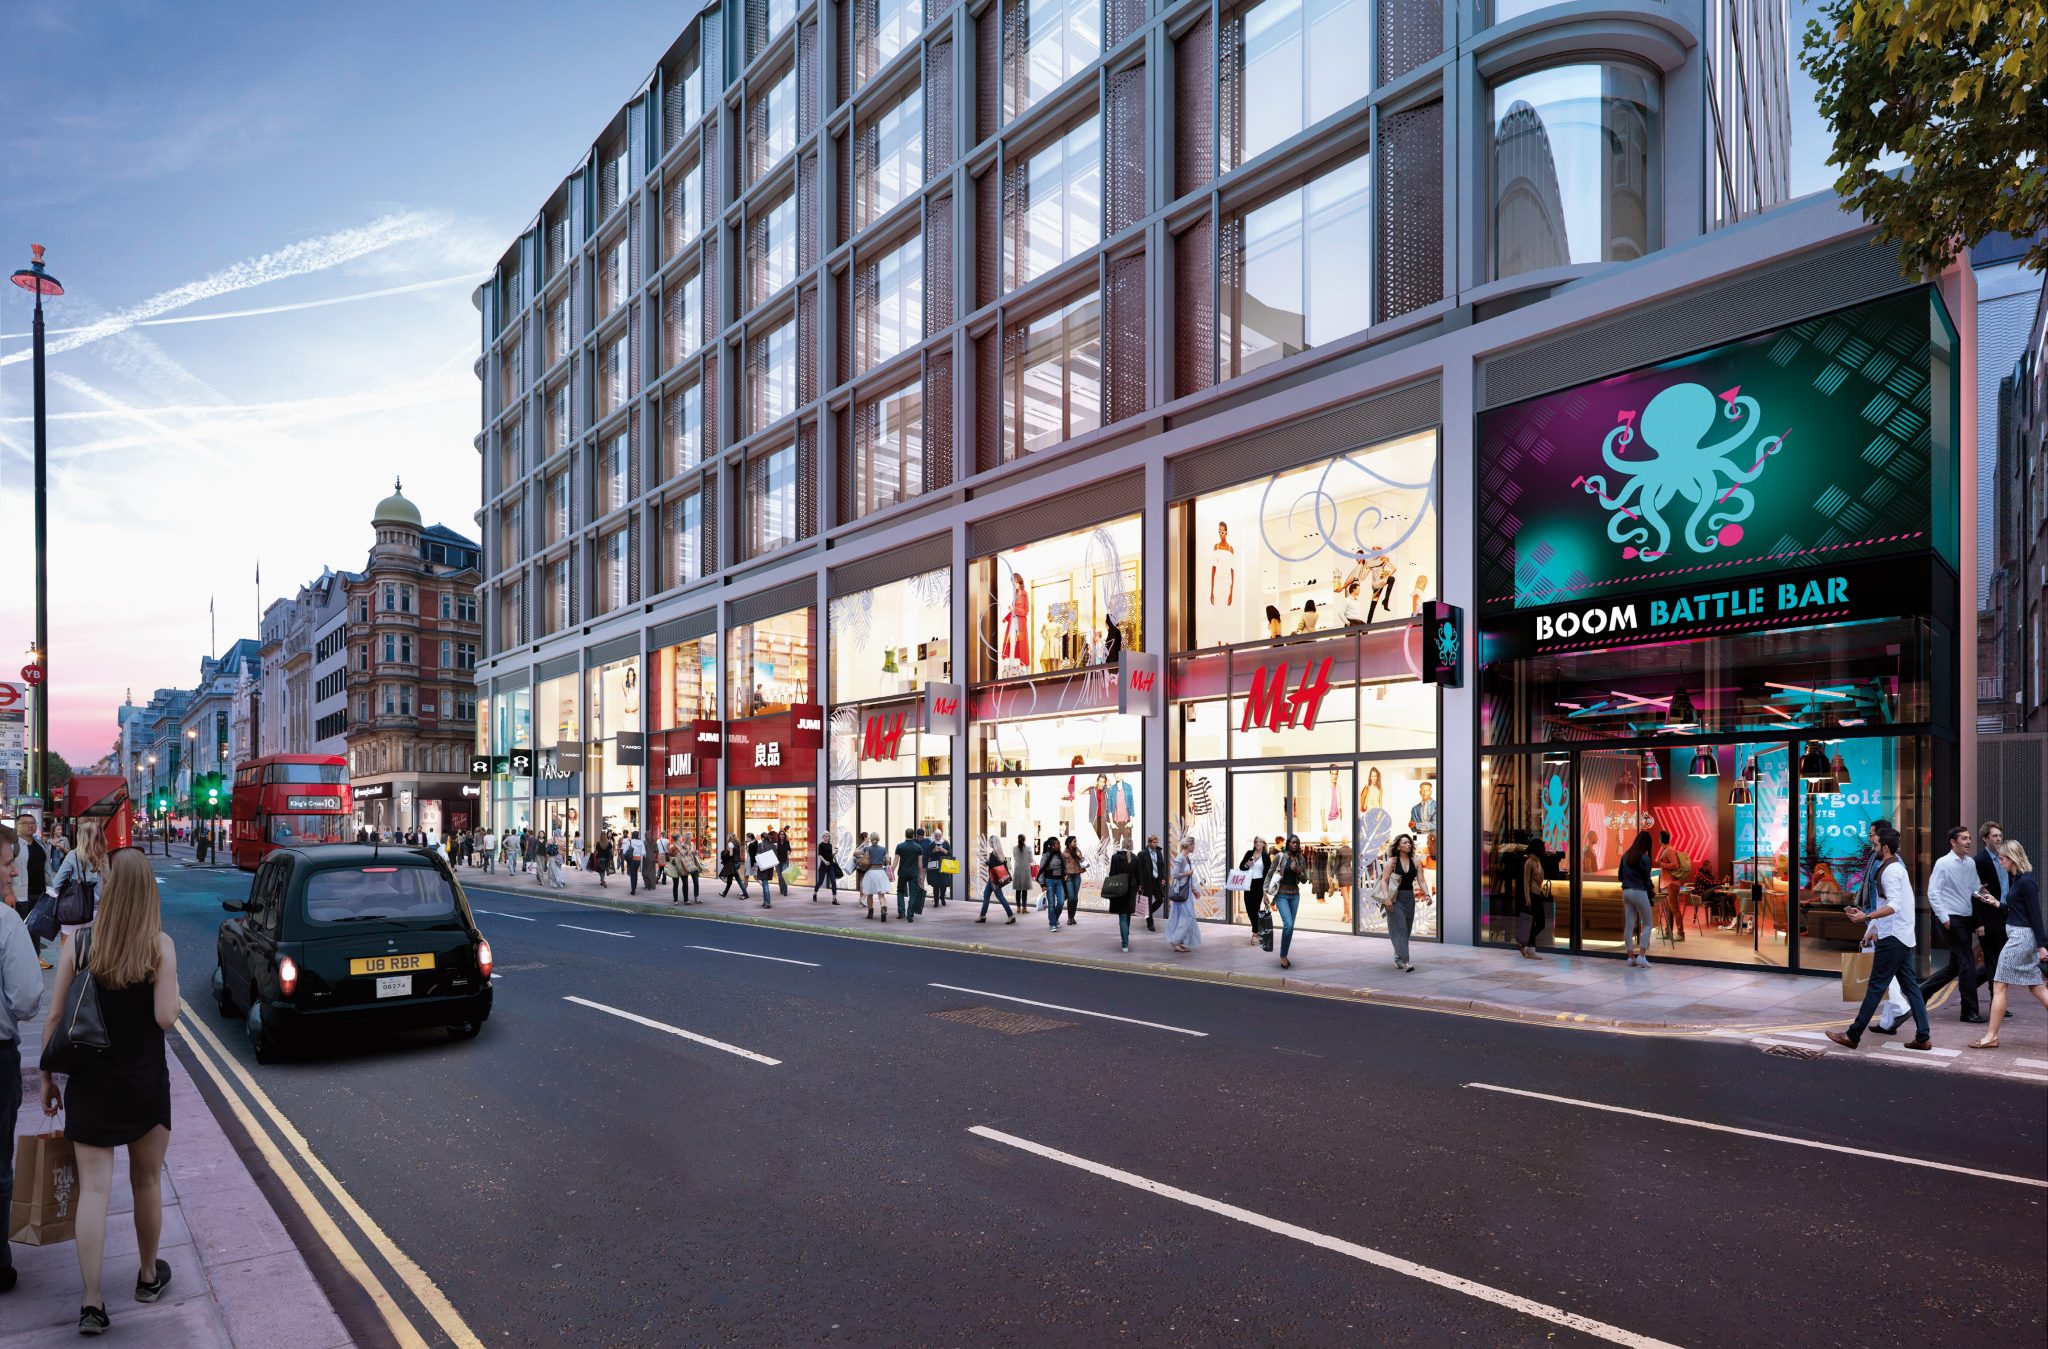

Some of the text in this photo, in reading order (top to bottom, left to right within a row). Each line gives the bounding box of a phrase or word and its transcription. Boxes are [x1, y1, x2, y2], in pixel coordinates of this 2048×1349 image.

[1536, 576, 1849, 641] BOOM BATTLE BAR
[25, 669, 41, 679] YB
[1240, 655, 1333, 734] M&H
[797, 718, 821, 730] JUMI
[697, 732, 720, 743] JUMI
[861, 711, 906, 762] M&H
[667, 752, 692, 777] JUMI
[754, 741, 781, 768] 良品
[290, 798, 335, 808] King's Cross 10
[366, 956, 420, 972] U8 RBR
